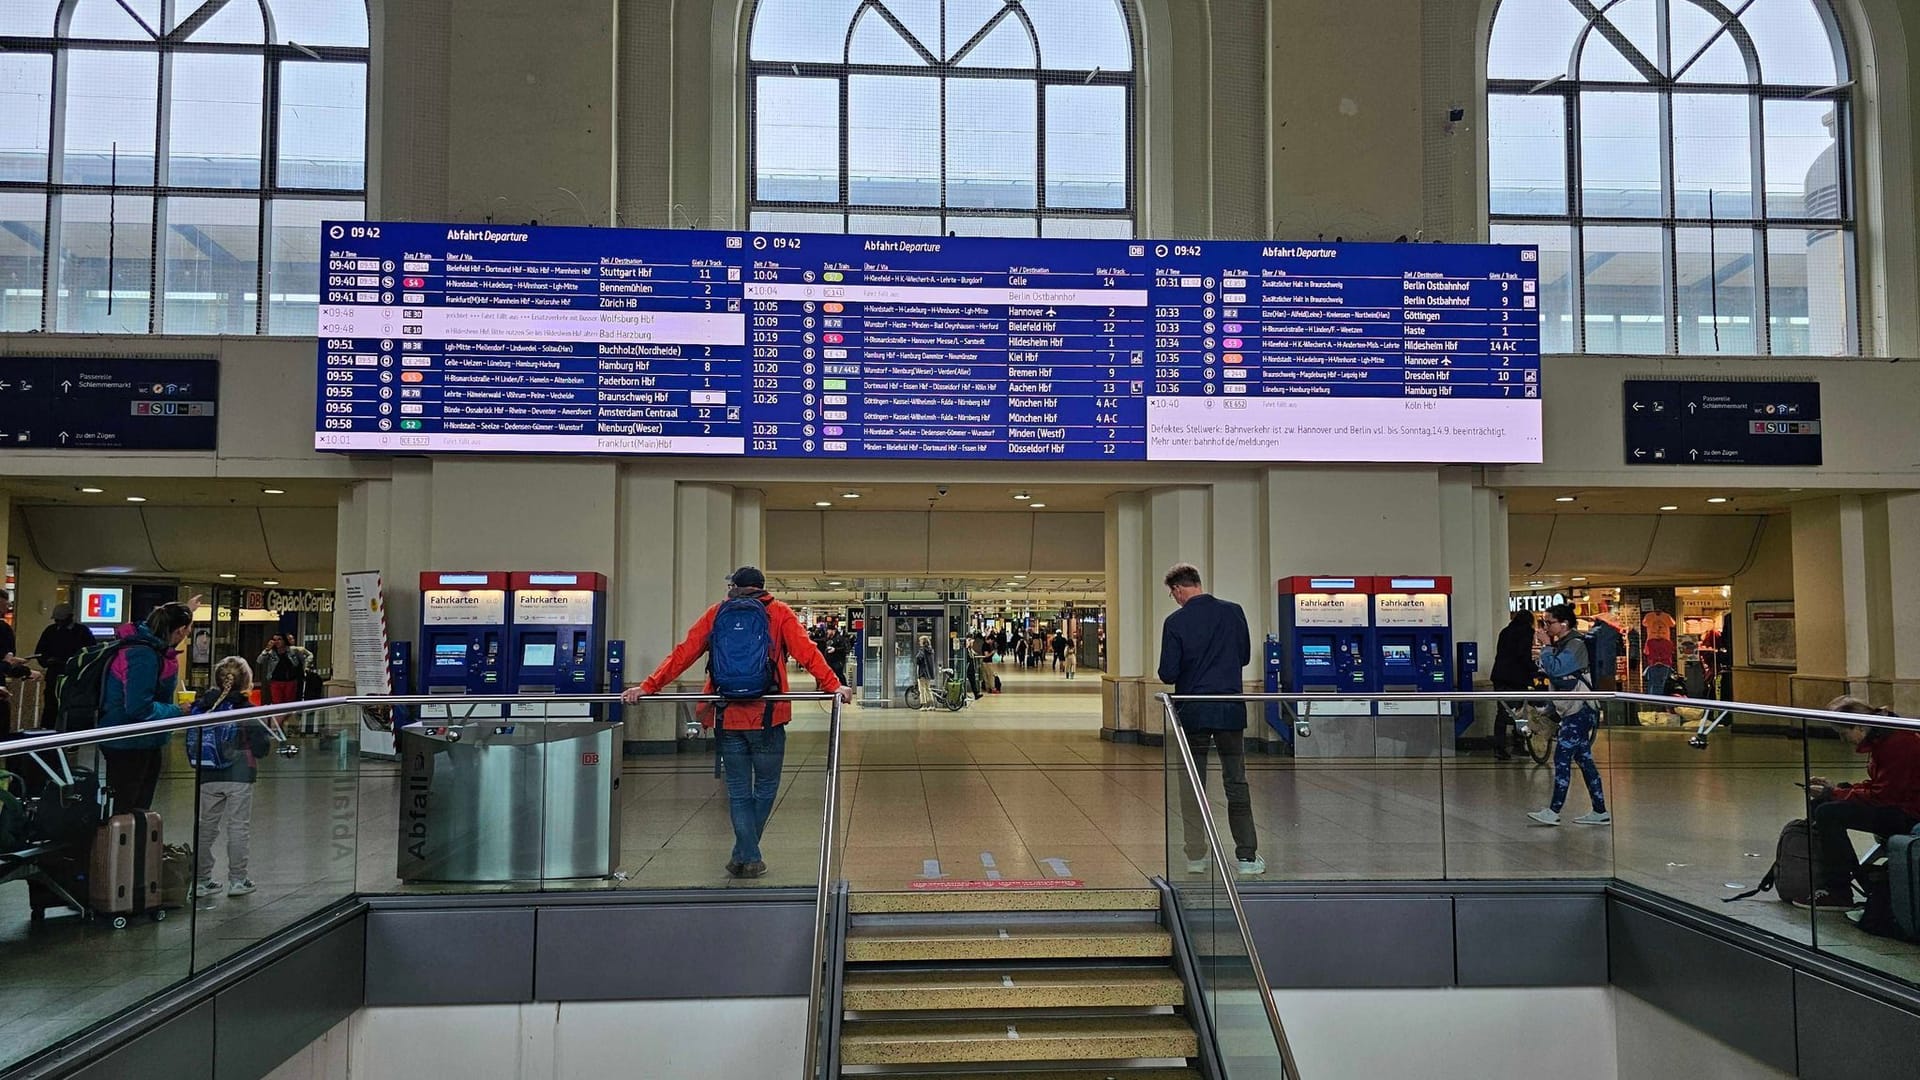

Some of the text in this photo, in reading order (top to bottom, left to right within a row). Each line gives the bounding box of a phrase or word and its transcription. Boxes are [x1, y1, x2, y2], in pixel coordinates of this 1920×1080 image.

[447, 229, 528, 243] Abfahrt Departure
[728, 238, 741, 247] DB
[865, 241, 940, 253] Abfahrt Departure
[1130, 246, 1143, 255] DB
[1175, 246, 1200, 256] 09:42
[1263, 247, 1336, 259] Abfahrt Departure
[1522, 251, 1535, 260] DB
[329, 261, 356, 270] 09:40
[600, 267, 652, 278] Stuttgart Hbf
[700, 270, 710, 278] 11
[754, 271, 778, 280] 10:04
[329, 277, 355, 286] 09:40
[1009, 276, 1027, 286] Celle
[1104, 278, 1114, 286] 14
[1156, 278, 1179, 287] 10:31
[600, 283, 652, 293] Bennemühlen
[1404, 281, 1470, 291] Berlin Ostbahnhof
[329, 292, 354, 302] 09:41
[1009, 292, 1075, 302] Berlin Ostbahnhof
[1404, 296, 1470, 305] Berlin Ostbahnhof
[600, 298, 637, 308] Zürich HB
[754, 302, 778, 311] 10:05
[1009, 307, 1043, 316] Hannover
[1156, 309, 1179, 317] 10:33
[1404, 310, 1440, 322] Göttingen
[600, 314, 638, 325] Wolfsburg
[641, 314, 654, 323] Hbf
[754, 318, 778, 326] 10:09
[1009, 322, 1056, 332] Bielefeld Hbf
[1104, 323, 1115, 332] 12
[1156, 324, 1179, 332] 10:33
[1404, 326, 1425, 335] Haste
[600, 330, 614, 338] Bad
[617, 330, 651, 340] Harzburg
[754, 333, 778, 342] 10:19
[328, 341, 353, 349] 09:51
[1009, 337, 1063, 347] Hildesheim Hbf
[1156, 339, 1179, 348] 10:34
[1405, 341, 1458, 350] Hildesheim Hbf
[1490, 342, 1516, 350] 14 A-C
[599, 345, 680, 356] Buchholz(Nordheide)
[753, 348, 778, 357] 10:20
[327, 356, 353, 365] 09:54
[1009, 353, 1038, 362] Kiel Hbf
[1156, 354, 1179, 362] 10:35
[1405, 356, 1439, 365] Hannover
[599, 361, 649, 372] Hamburg Hbf
[753, 364, 778, 372] 10:20
[327, 372, 353, 381] 09:55
[1009, 368, 1052, 377] Bremen Hbf
[1156, 369, 1179, 378] 10:36
[1405, 371, 1450, 380] Dresden Hbf
[1498, 372, 1509, 381] 10
[598, 376, 655, 386] Paderborn Hbf
[753, 379, 778, 388] 10:23
[1009, 383, 1052, 392] Aachen Hbf
[1104, 384, 1115, 392] 13
[1156, 384, 1179, 393] 10:36
[1405, 386, 1452, 397] Hamburg Hbf
[327, 388, 352, 397] 09:55
[598, 392, 668, 403] Braunschweig Hbf
[753, 394, 778, 403] 10:26
[1009, 398, 1057, 407] München Hbf
[1104, 399, 1118, 408] A-C
[1406, 401, 1436, 410] Köln Hbf
[326, 404, 352, 413] 09:56
[598, 408, 678, 418] Amsterdam Centraal
[699, 409, 710, 418] 12
[1009, 413, 1057, 423] München Hbf
[1104, 414, 1118, 423] A-C
[326, 420, 352, 429] 09:58
[598, 423, 662, 434] Nienburg(Weser)
[753, 426, 778, 434] 10:28
[1009, 428, 1065, 439] Minden (Westf)
[1152, 424, 1183, 433] Defektes
[1187, 425, 1222, 433] Stellwerk:
[1225, 425, 1270, 434] Bahnverkehr
[1273, 426, 1282, 434] ist
[1298, 426, 1332, 434] Hannover
[1335, 426, 1348, 434] und
[1350, 426, 1371, 435] Berlin
[1388, 426, 1398, 435] bis
[753, 441, 777, 450] 10:31
[1151, 437, 1170, 445] Mehr
[1009, 444, 1064, 453] Düsseldorf Hbf
[1104, 444, 1115, 453] 12
[248, 590, 334, 613] DB GepäckCenter
[584, 753, 599, 765] DB
[408, 775, 428, 861] Abfall
